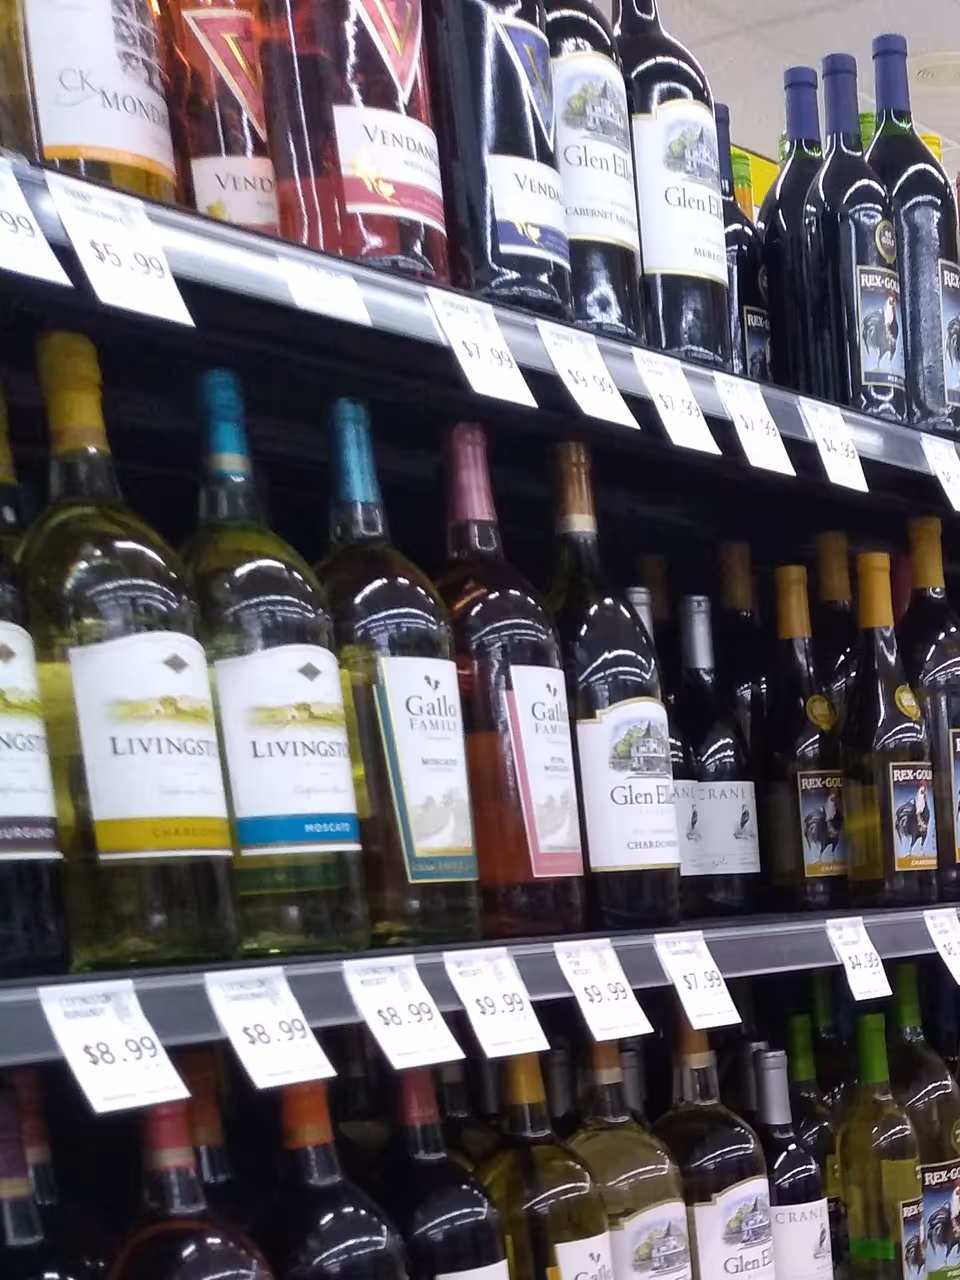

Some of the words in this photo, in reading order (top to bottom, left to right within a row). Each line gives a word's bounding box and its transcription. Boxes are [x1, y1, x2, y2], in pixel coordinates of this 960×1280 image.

[563, 144, 611, 171] Glen
[664, 186, 706, 210] Glen
[89, 237, 166, 281] $5.99
[461, 339, 514, 371] $7.99
[566, 368, 614, 396] $9.99
[658, 392, 702, 419] $7.99
[404, 693, 457, 718] Gallo
[609, 783, 654, 806] Glen
[583, 981, 628, 1005] $9.99
[682, 969, 722, 991] $7.99
[377, 1001, 434, 1027] $8.99
[475, 992, 525, 1017] $9.99
[242, 1018, 308, 1046] $8.99
[83, 1035, 158, 1066] $8.99
[723, 1256, 760, 1276] Glen
